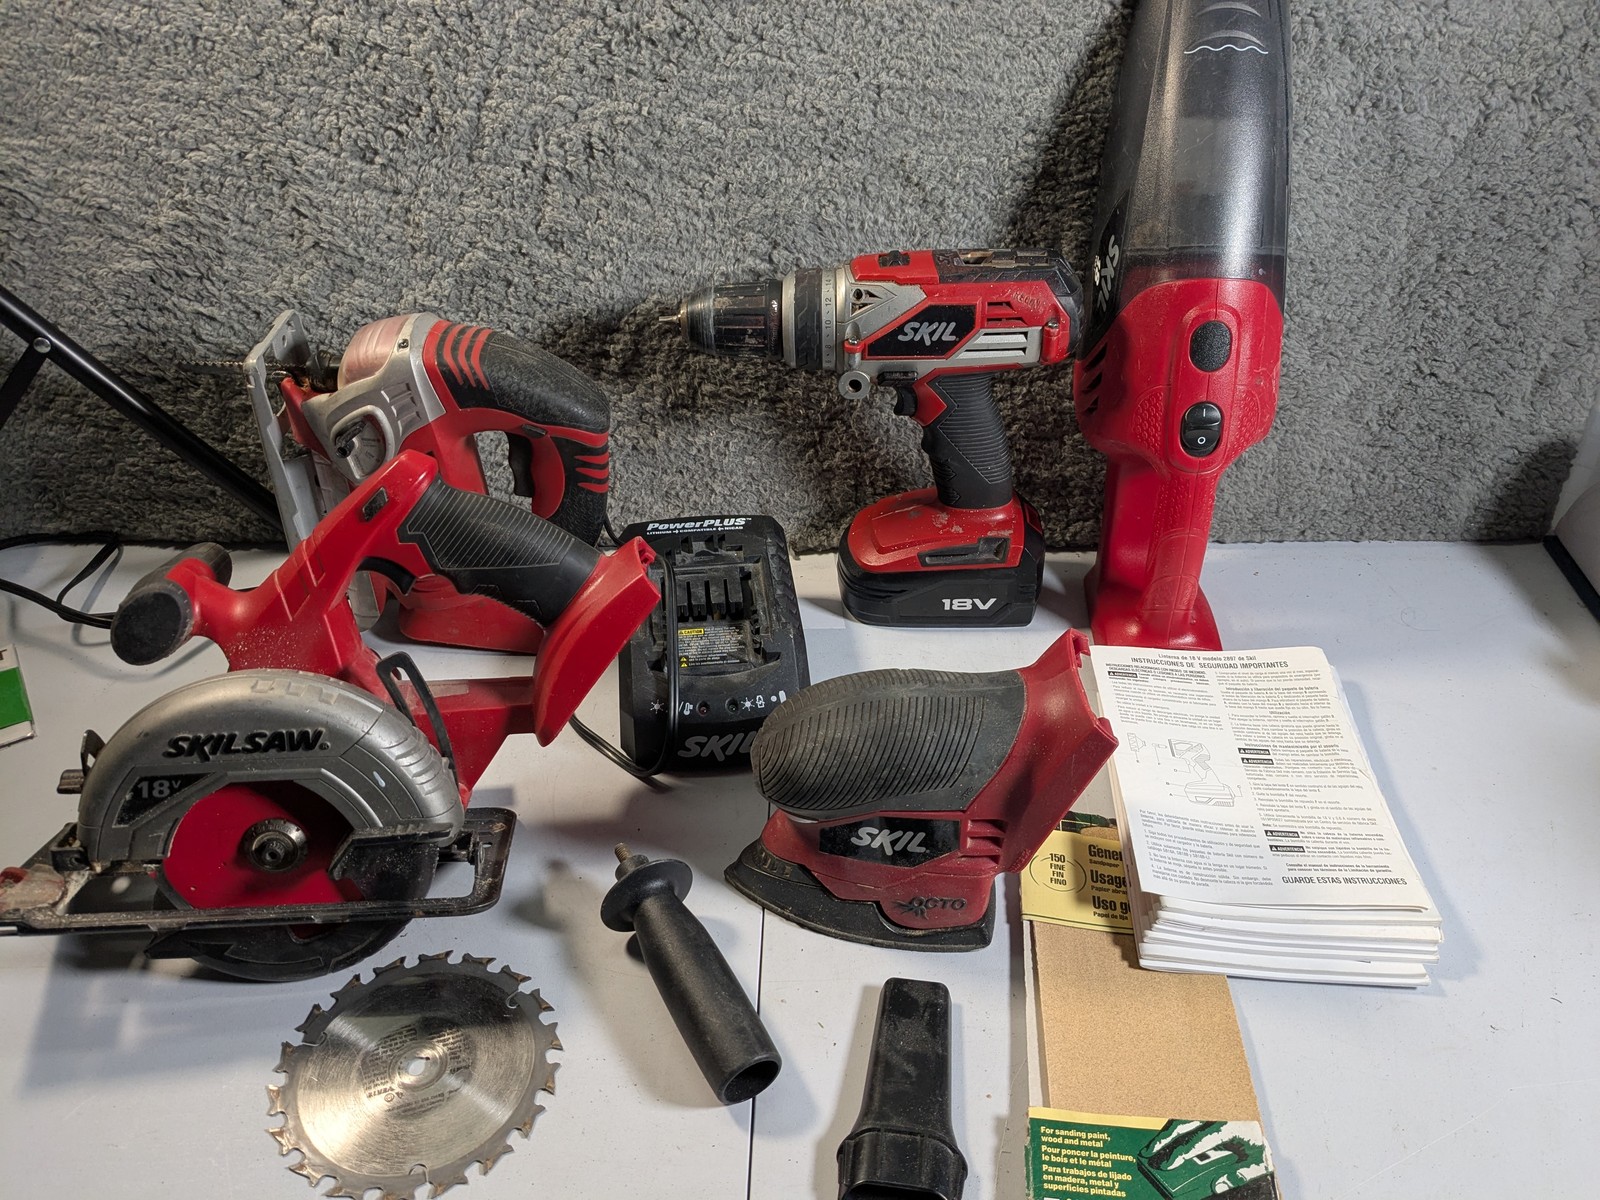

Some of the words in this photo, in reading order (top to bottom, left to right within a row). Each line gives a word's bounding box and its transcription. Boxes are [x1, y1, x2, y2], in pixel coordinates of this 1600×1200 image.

[1097, 234, 1120, 312] SKIL
[825, 296, 832, 307] 12
[825, 319, 832, 330] 10
[898, 322, 957, 346] SKIL
[942, 598, 997, 610] 18V
[1131, 657, 1184, 668] INSTRUCCIONES
[850, 827, 926, 856] SKIL
[1050, 853, 1065, 863] 150
[1089, 858, 1119, 868] Sandpaper
[1050, 863, 1066, 871] FINE
[1050, 878, 1066, 886] FINO
[911, 897, 967, 910] OCTO
[1092, 895, 1116, 911] Uso
[1055, 1128, 1086, 1138] sanding
[1088, 1132, 1110, 1141] paint,
[1042, 1145, 1060, 1153] Pour
[1061, 1148, 1089, 1157] poncer
[1100, 1152, 1136, 1162] peinture,
[1051, 1155, 1068, 1163] bois
[1042, 1164, 1061, 1173] Para
[1063, 1167, 1096, 1177] trabajos
[1109, 1171, 1132, 1180] lijado
[1055, 1175, 1088, 1185] madera,
[1044, 1183, 1089, 1194] superficies
[1091, 1186, 1126, 1197] pintadas
